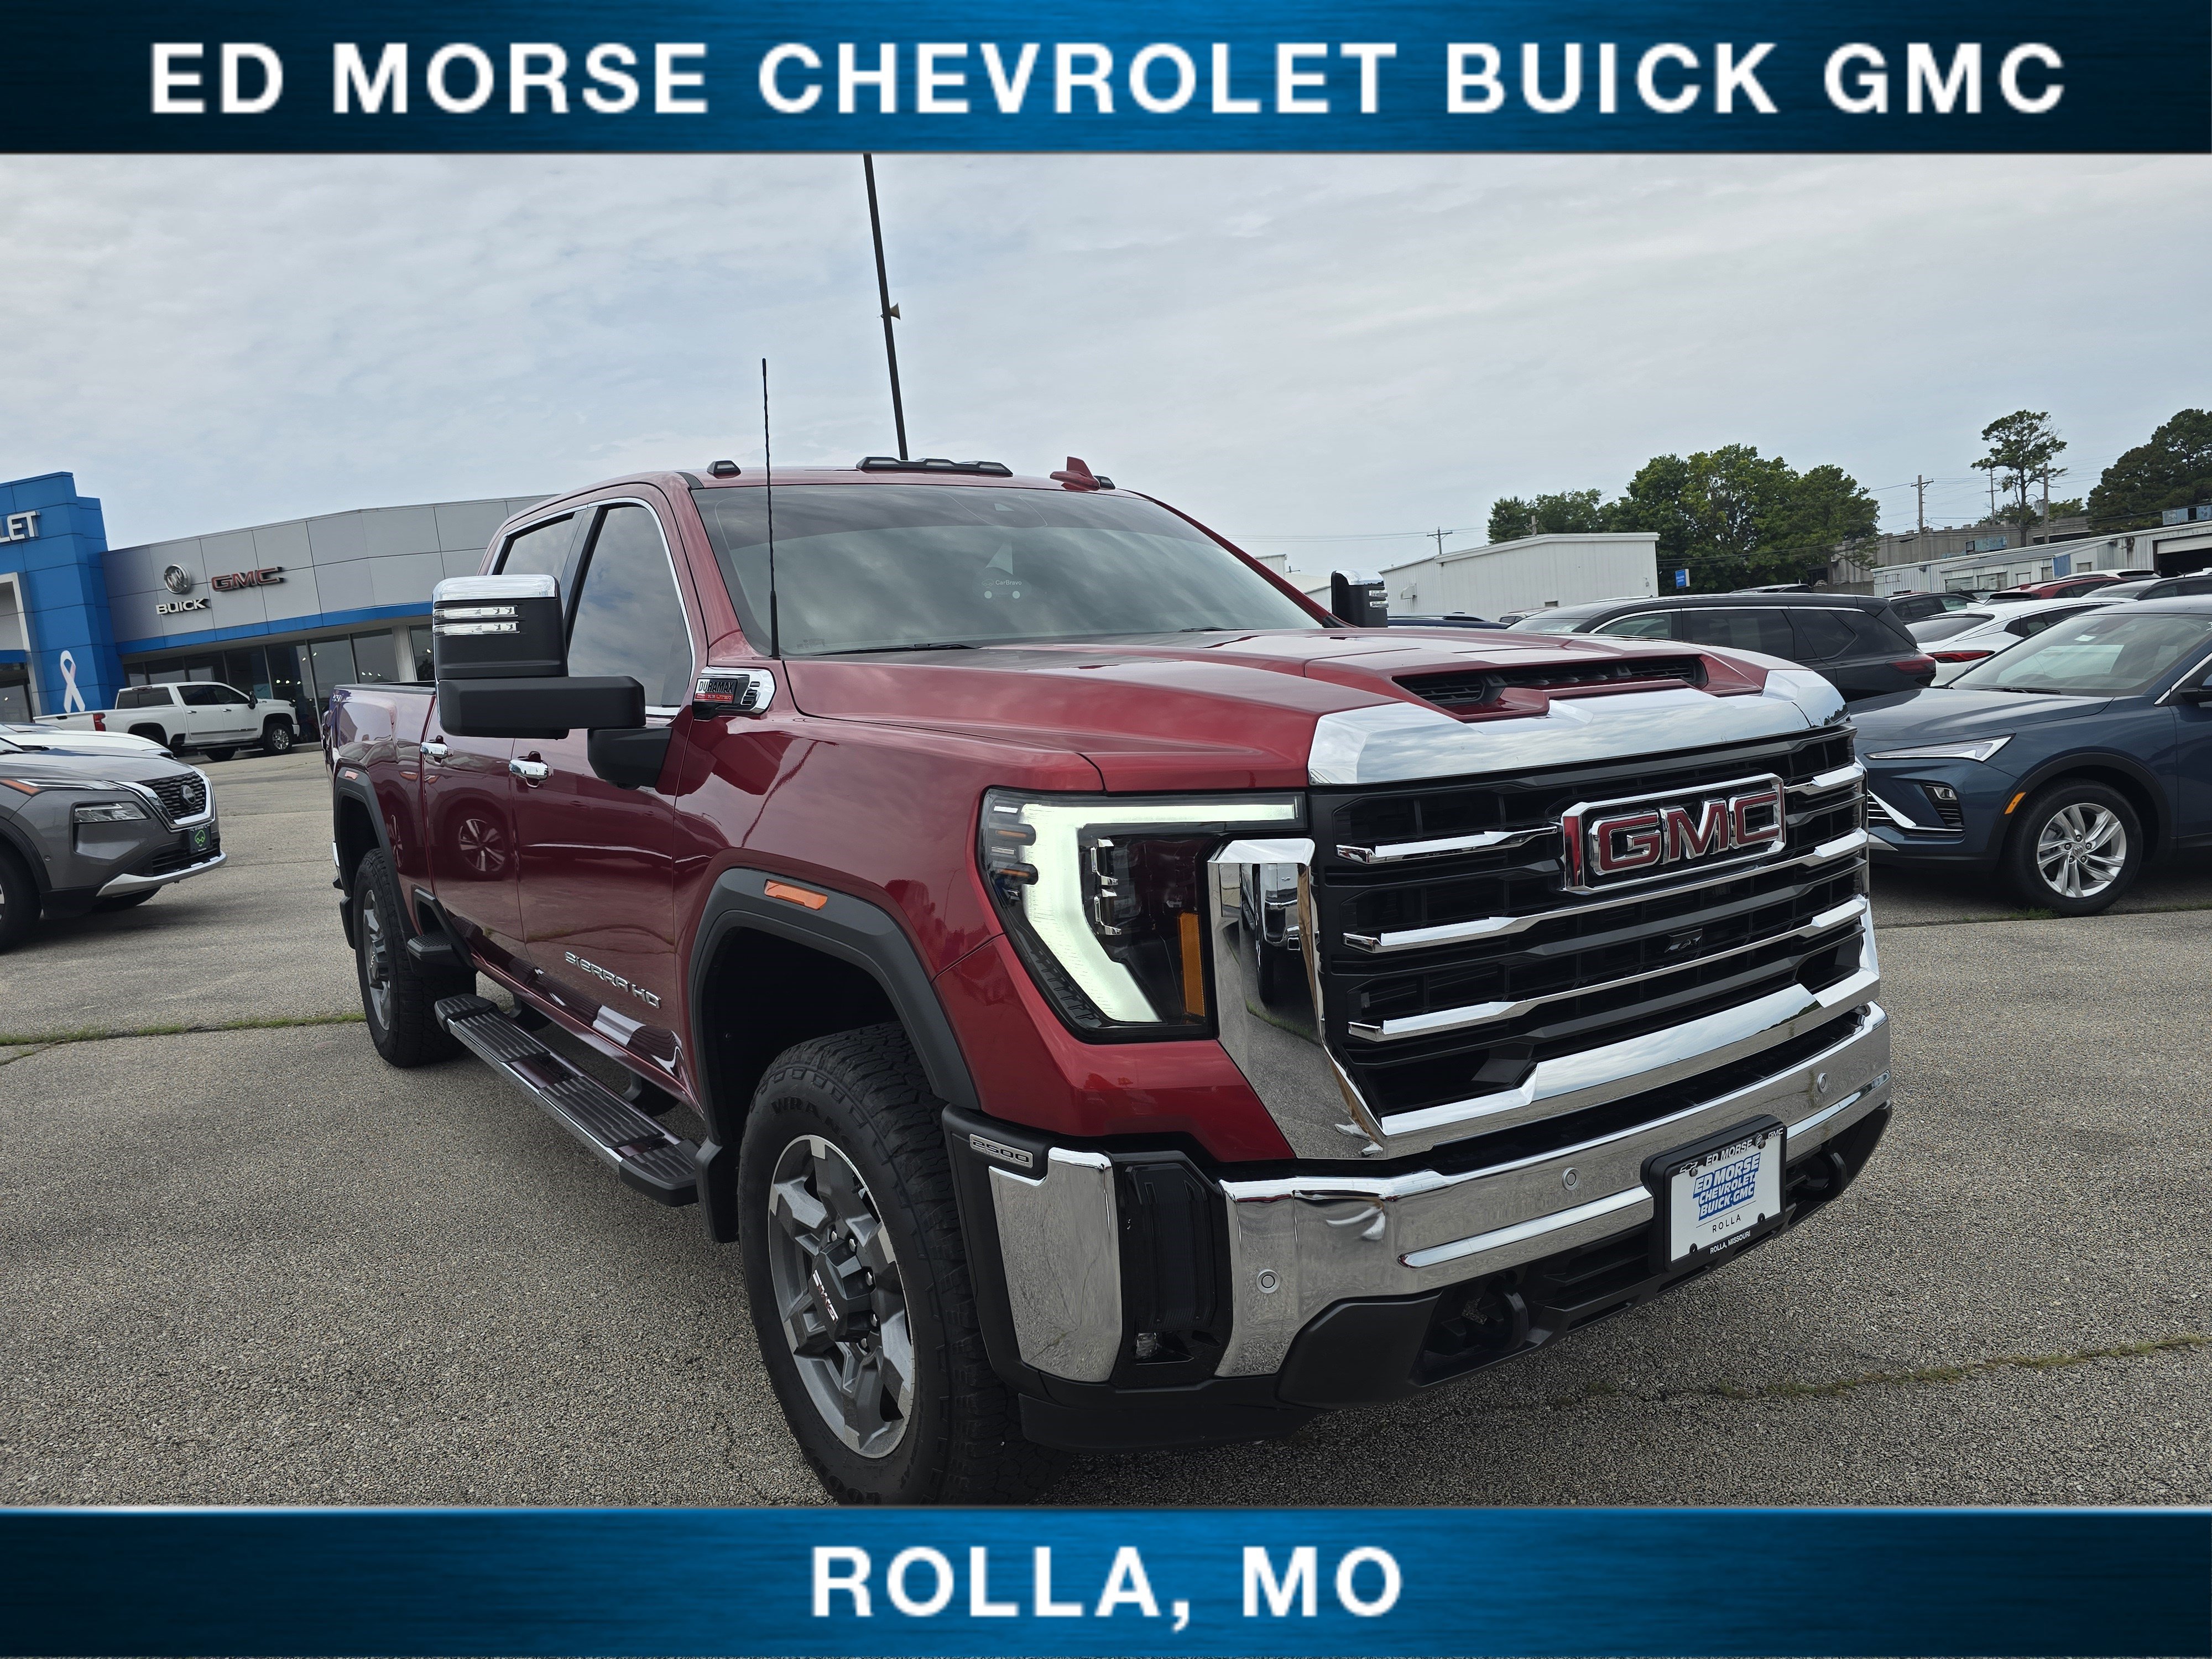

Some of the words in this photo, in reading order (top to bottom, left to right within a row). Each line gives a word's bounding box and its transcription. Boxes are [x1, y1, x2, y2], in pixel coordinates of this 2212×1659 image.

[211, 567, 281, 592] GMC
[156, 598, 207, 615] BUICK
[698, 681, 734, 693] DURAMAX
[1589, 789, 1780, 875] GMC
[565, 951, 629, 993] SIERRA
[632, 984, 661, 1009] HD
[1768, 1128, 1783, 1139] GMC
[973, 1139, 1029, 1162] 2500
[1706, 1153, 1718, 1166] ED
[1720, 1139, 1752, 1161] MORSE
[1694, 1173, 1713, 1195] ED
[1713, 1153, 1761, 1187] MORSE
[1712, 1214, 1741, 1233] ROLLA
[1709, 1241, 1727, 1254] ROLLA,
[1728, 1230, 1751, 1246] MISSOURI
